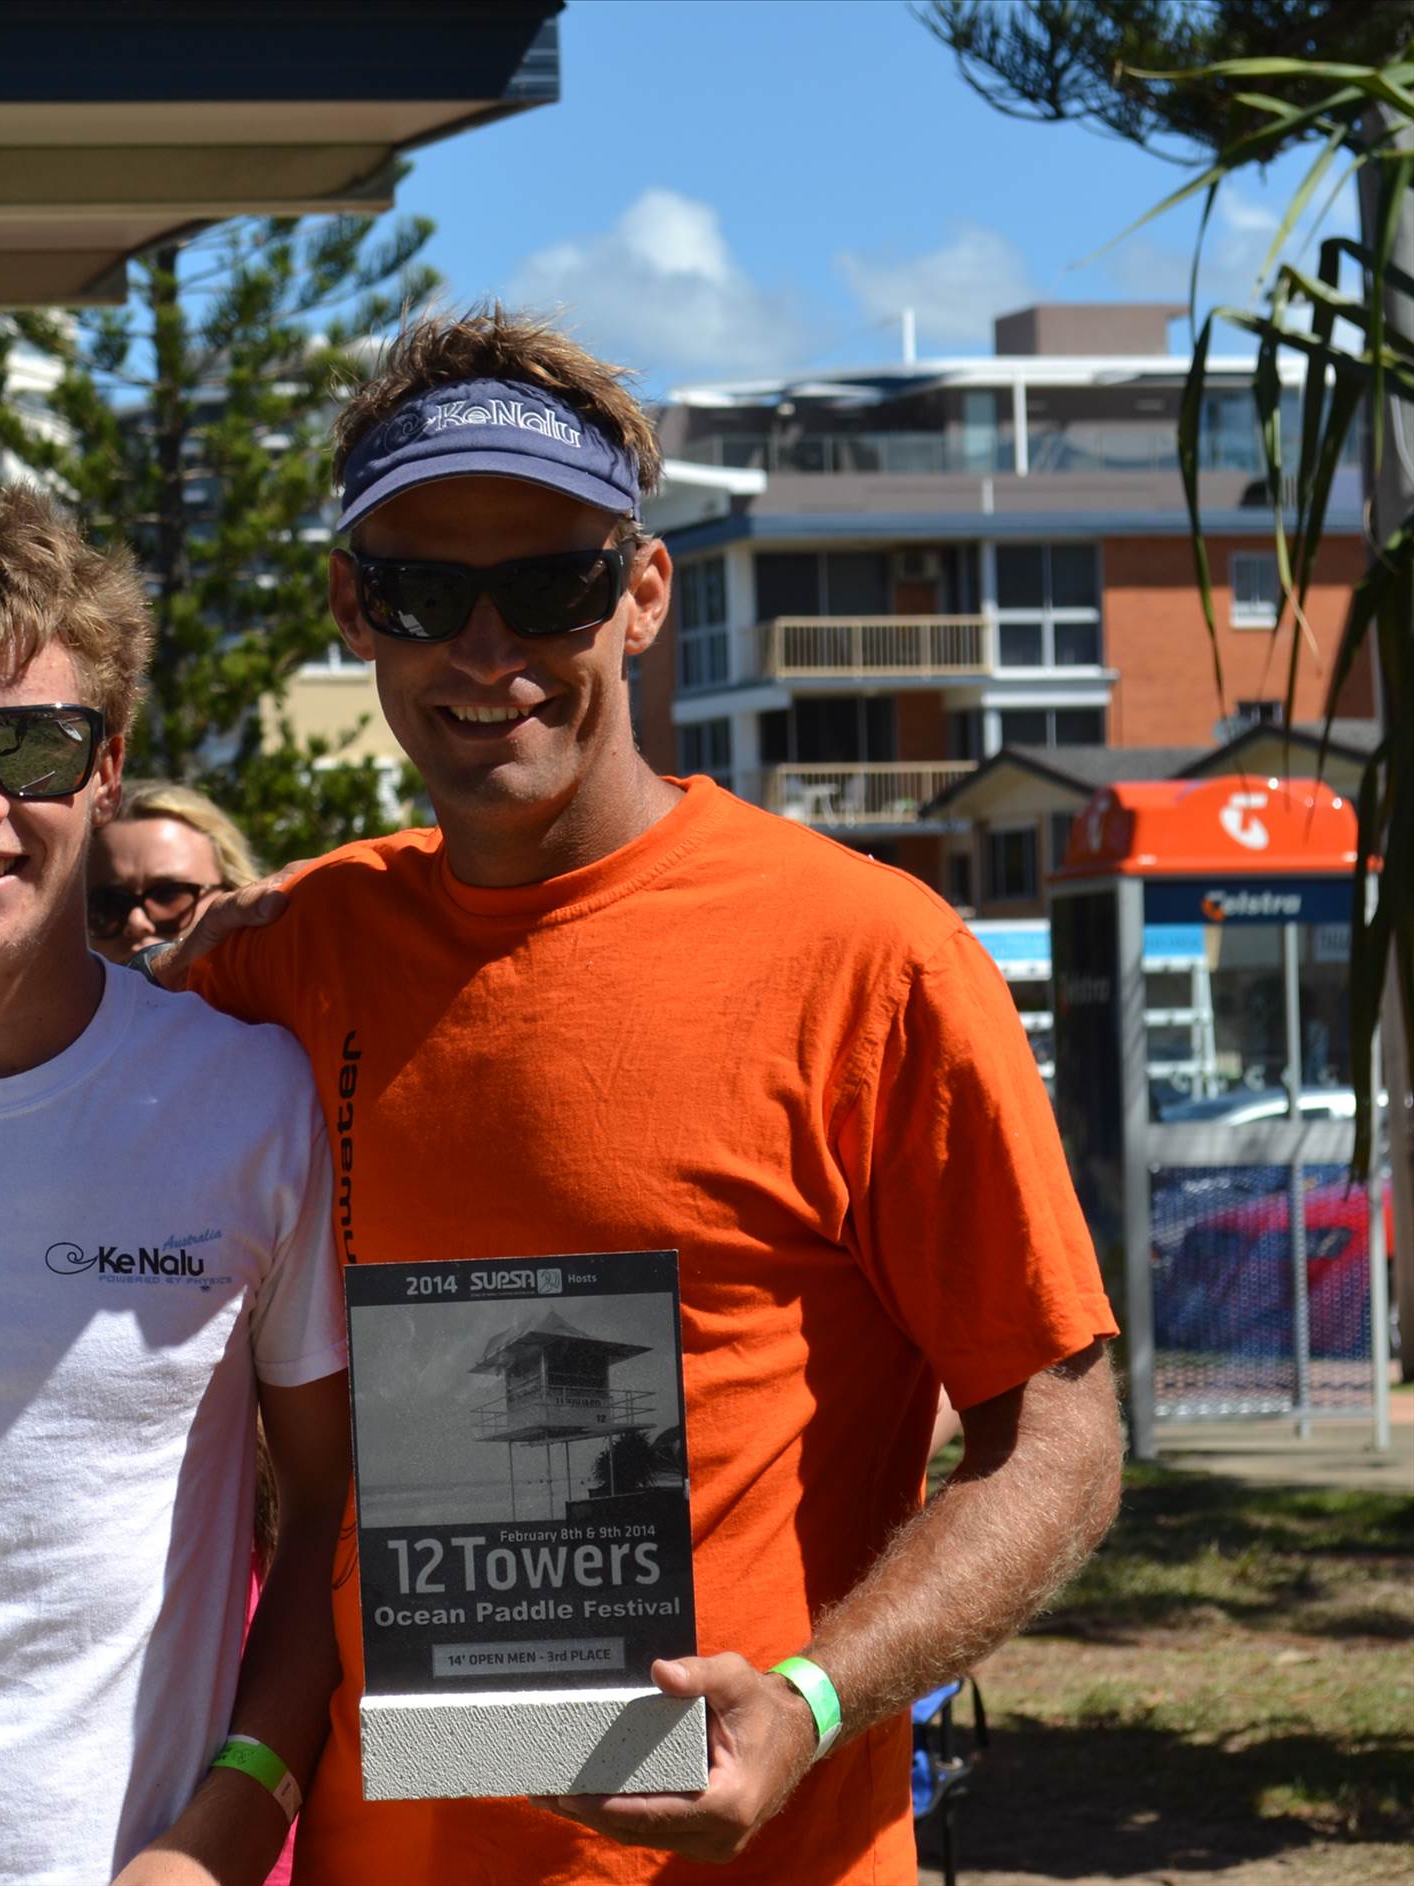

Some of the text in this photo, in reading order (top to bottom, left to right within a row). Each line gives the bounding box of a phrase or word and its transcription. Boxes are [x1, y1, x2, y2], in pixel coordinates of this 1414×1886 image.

[163, 1228, 223, 1250] Australia
[98, 1275, 233, 1285] POWERED BY PHYSICS
[406, 1275, 458, 1296] 2014
[568, 1273, 597, 1283] Hosts
[500, 1525, 656, 1543] February 8th & 9th 2014
[374, 1597, 681, 1627] Ocean Paddle Festival
[469, 1652, 505, 1665] OPEN
[507, 1651, 536, 1664] MEN
[546, 1650, 568, 1663] 3rd
[571, 1648, 611, 1662] PLACE
